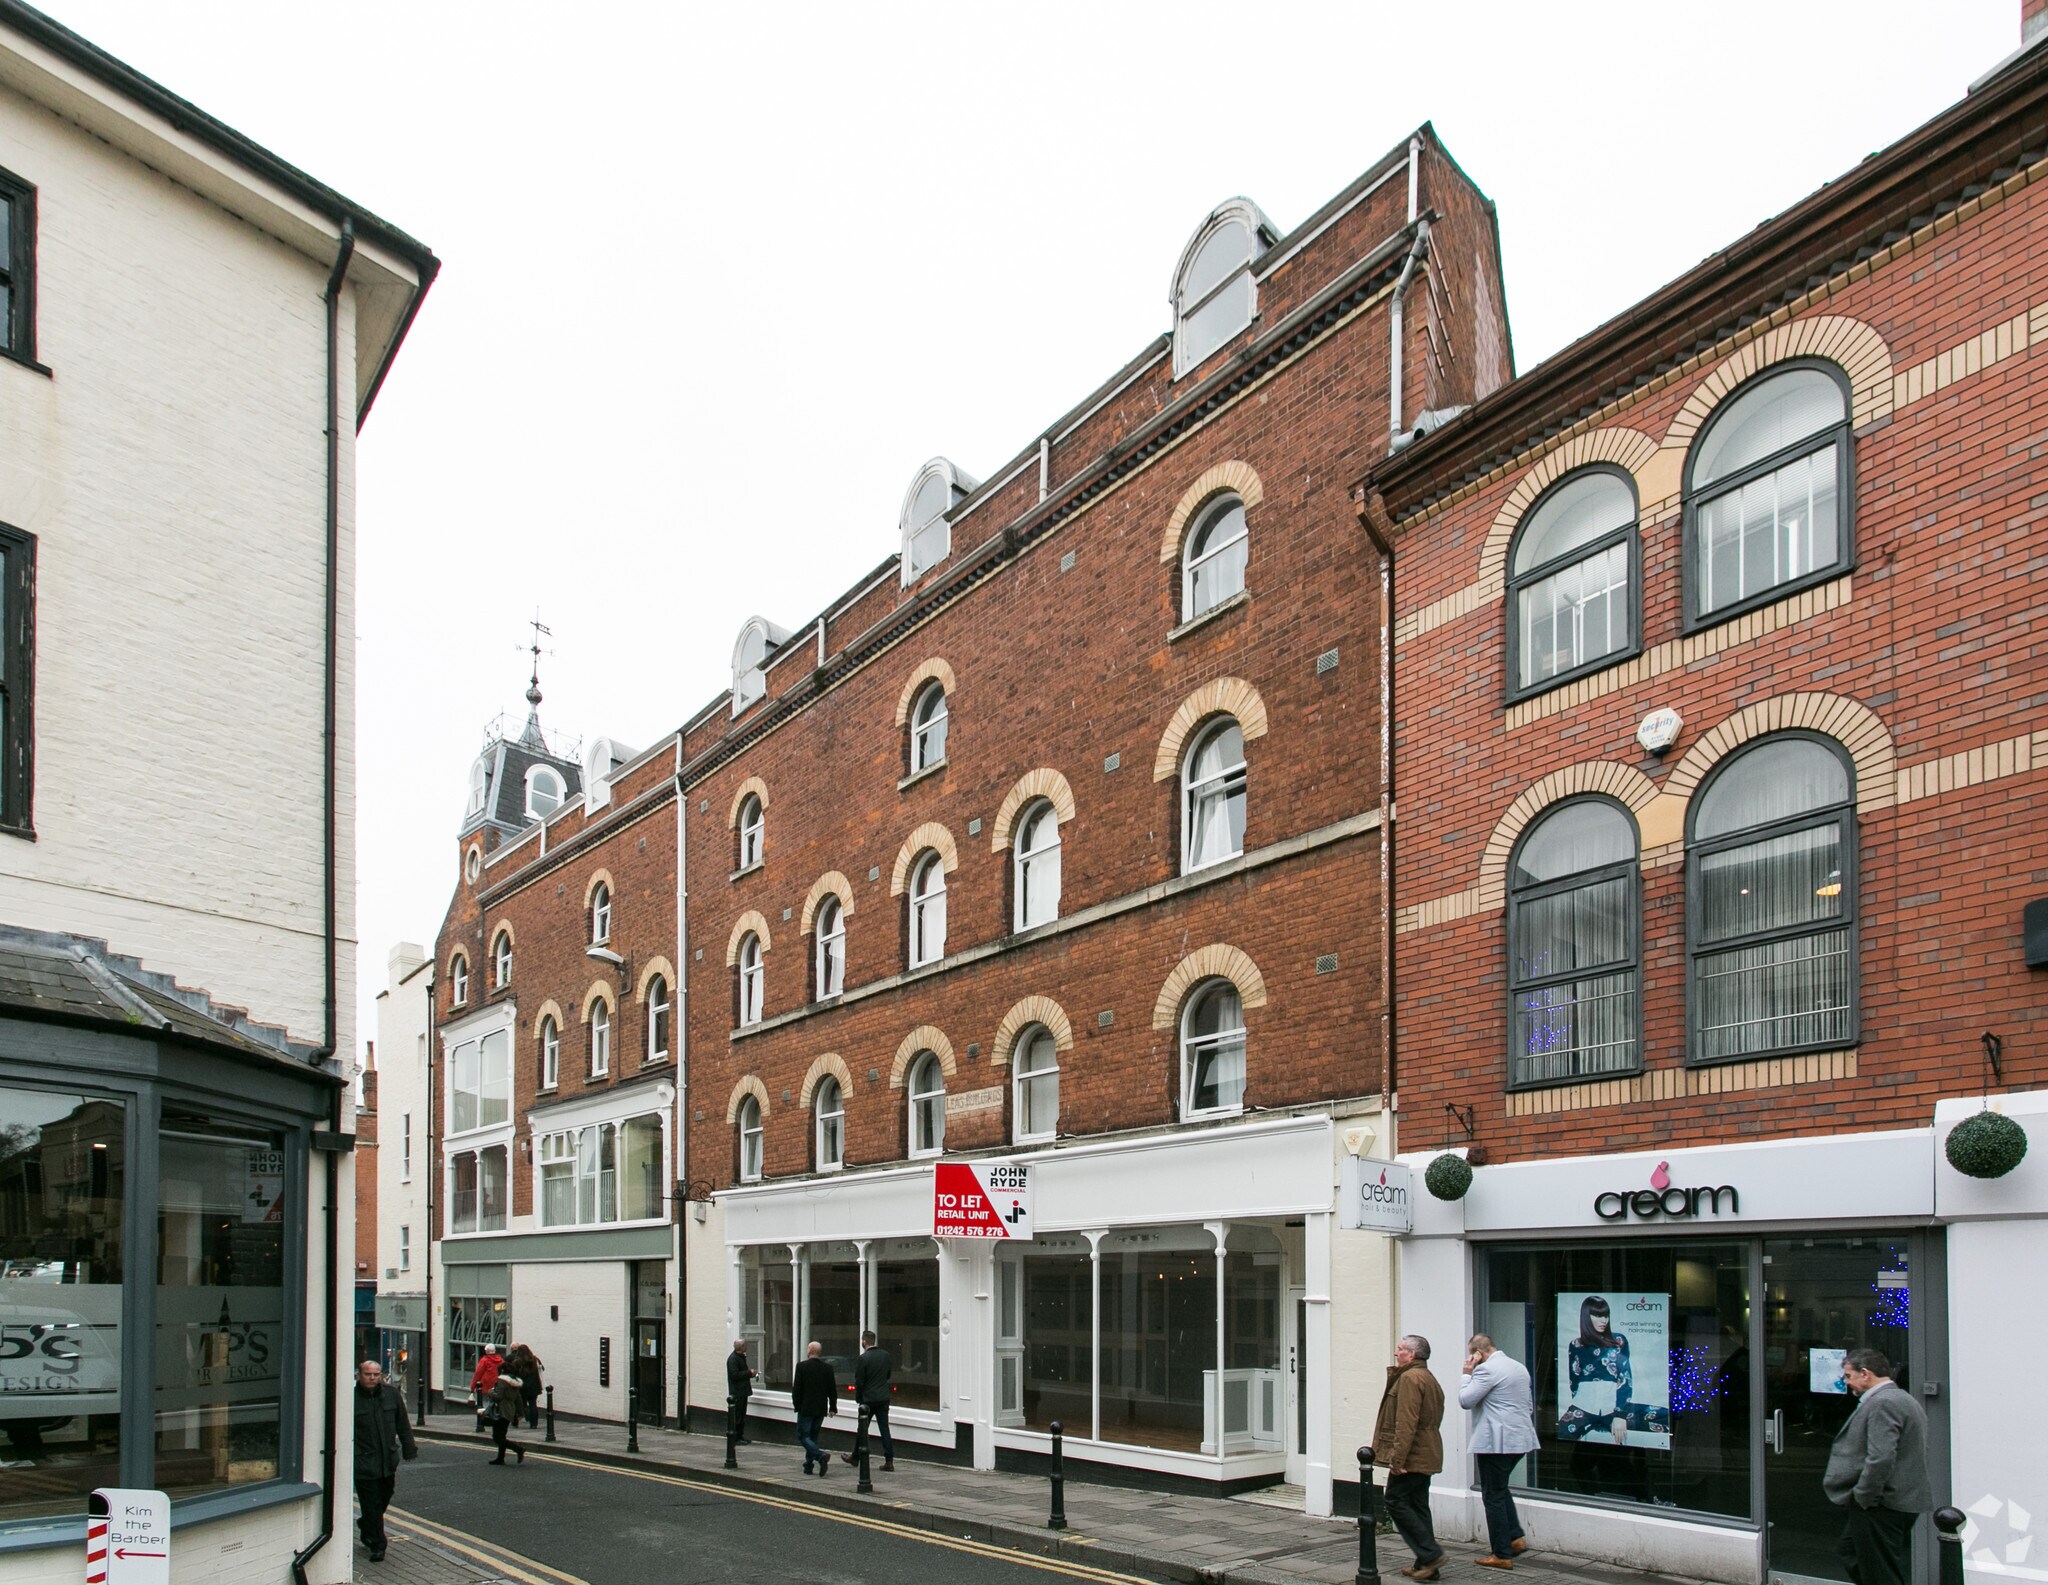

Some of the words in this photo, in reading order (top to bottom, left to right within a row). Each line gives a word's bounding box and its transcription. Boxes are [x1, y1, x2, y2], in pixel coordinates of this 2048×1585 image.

[990, 1167, 1027, 1177] JOHN
[990, 1178, 1027, 1188] RYDE
[1361, 1182, 1407, 1205] cream
[937, 1194, 957, 1207] TO
[961, 1195, 982, 1208] LET
[1594, 1185, 1739, 1219] cream
[937, 1209, 966, 1219] RETAIL
[968, 1211, 989, 1220] UNIT
[1383, 1206, 1406, 1215] beauty
[936, 1225, 965, 1235] 01242
[967, 1226, 984, 1236] 576
[986, 1227, 1004, 1236] 276
[1626, 1302, 1662, 1311] cream
[229, 1363, 269, 1378] ESIGN
[2, 1375, 80, 1391] ESIGN
[125, 1506, 152, 1516] Kim
[125, 1520, 152, 1530] the
[111, 1533, 166, 1544] Barber
